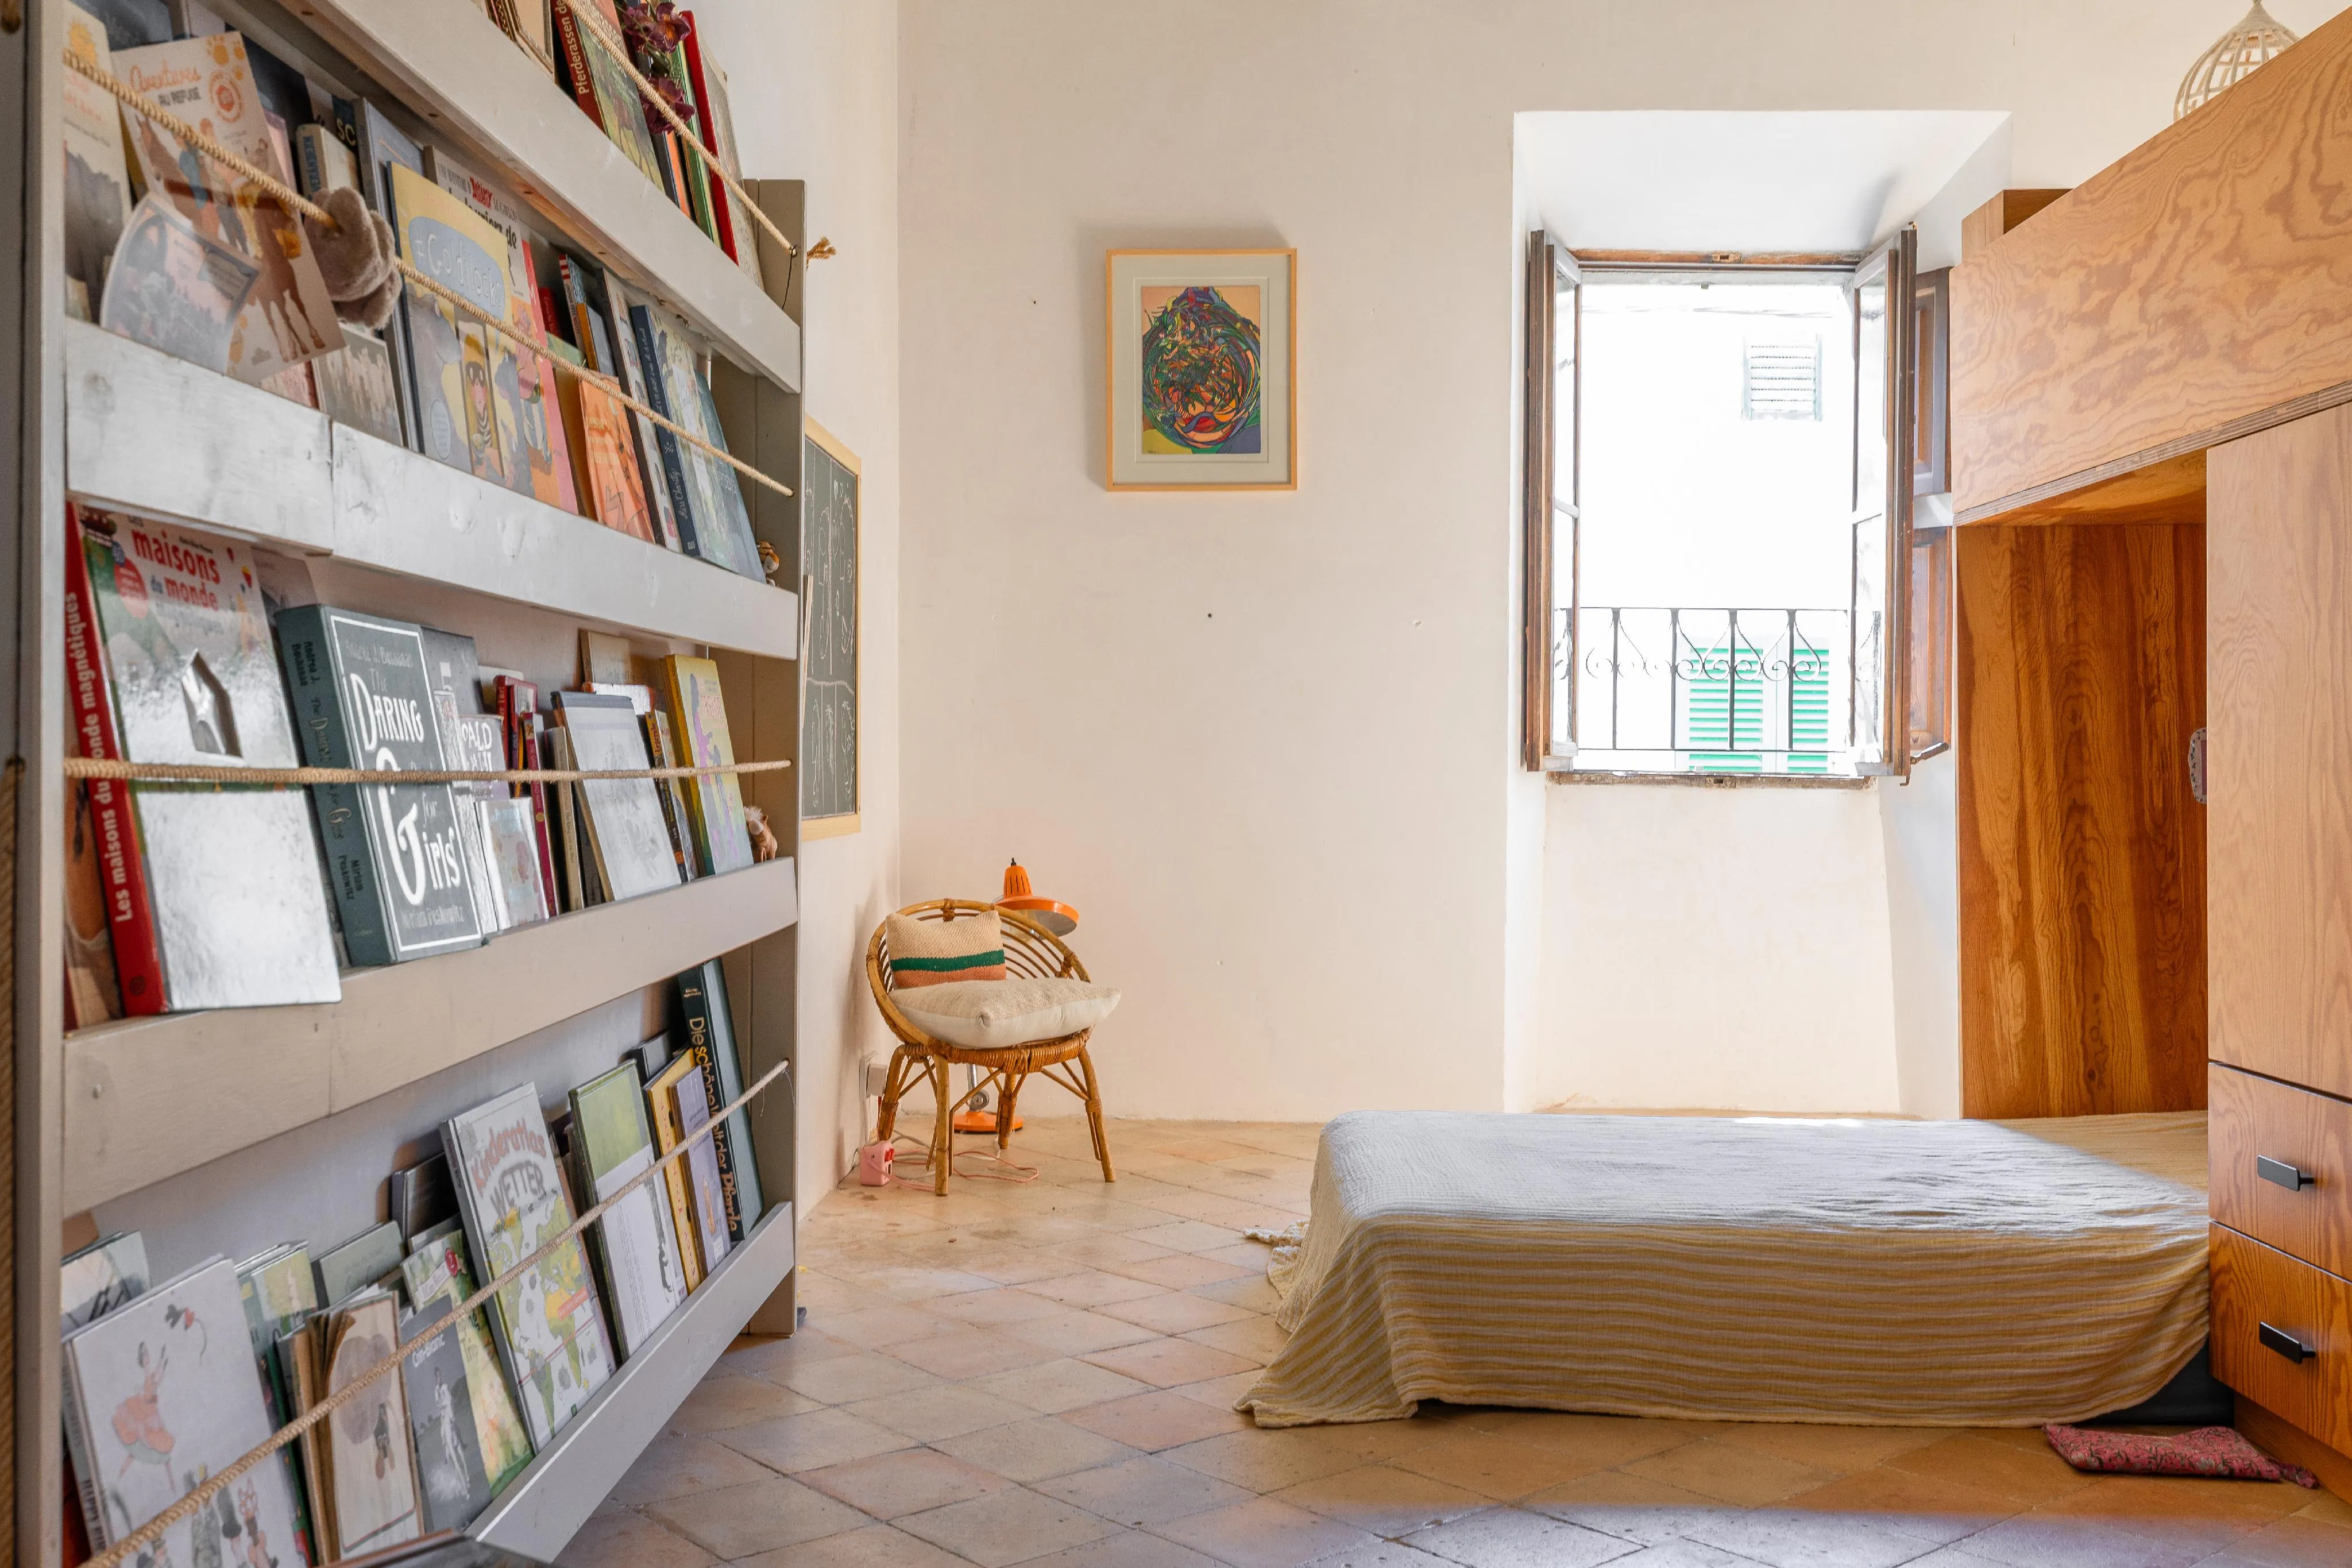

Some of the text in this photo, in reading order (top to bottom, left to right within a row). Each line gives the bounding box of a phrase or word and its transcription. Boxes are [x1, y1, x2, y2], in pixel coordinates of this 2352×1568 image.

[561, 17, 590, 95] Pferderassen
[131, 529, 221, 585] maisons
[164, 576, 220, 612] monde
[303, 640, 317, 674] Andrea
[350, 673, 425, 754] DARING
[65, 592, 133, 922] Les maisons du onde magnétiques
[422, 791, 438, 828] for
[689, 1017, 706, 1045] Die
[490, 1158, 547, 1219] WETTER
